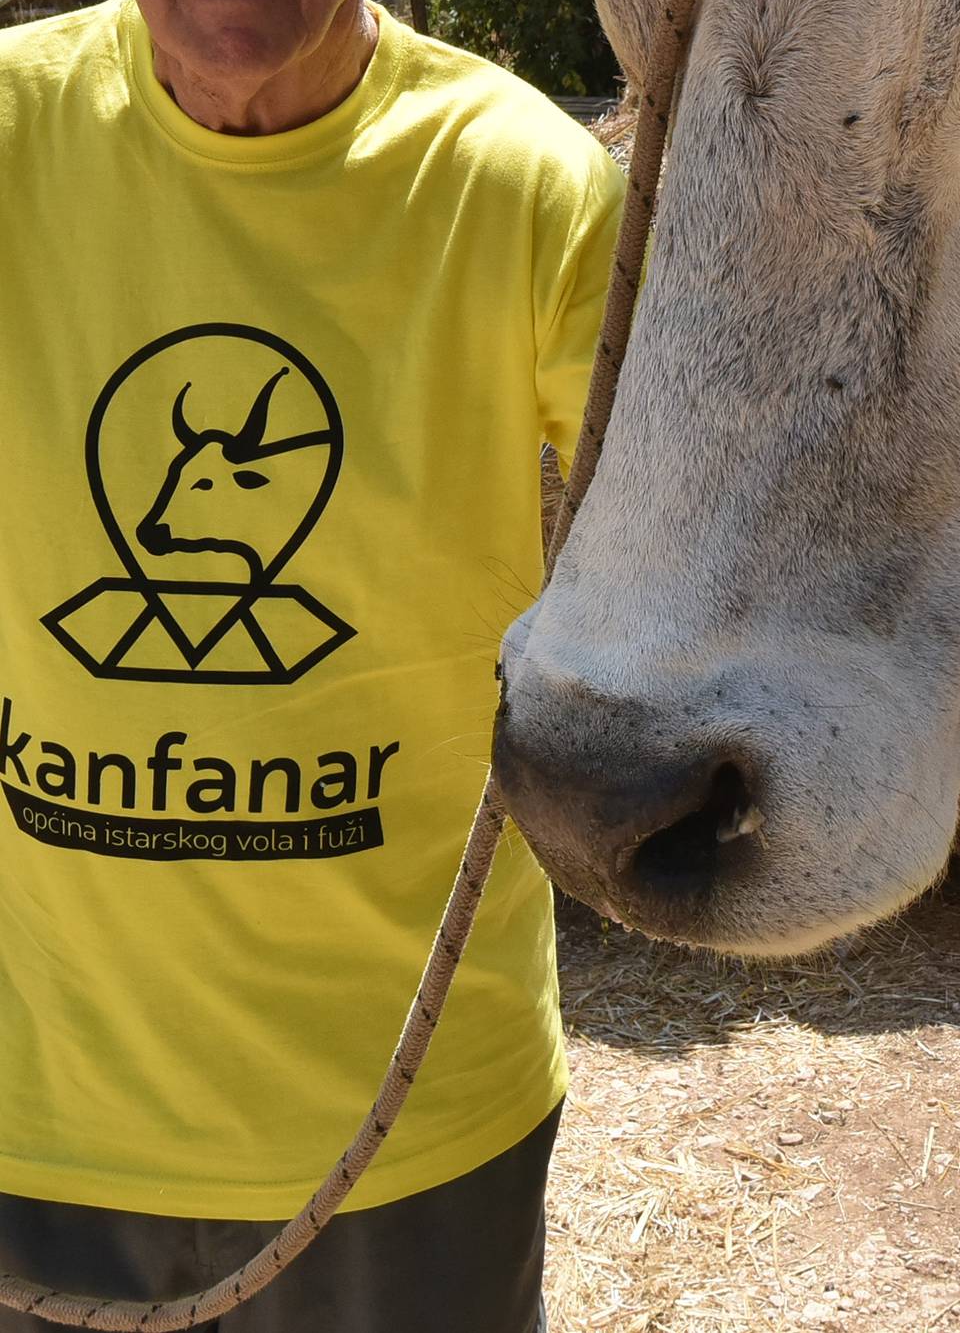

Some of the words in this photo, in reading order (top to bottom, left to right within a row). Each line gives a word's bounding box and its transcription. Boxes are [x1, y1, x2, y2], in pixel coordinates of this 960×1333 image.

[0, 697, 399, 813] kanfanar
[23, 807, 96, 841] općina
[105, 822, 227, 856] istarskog
[236, 829, 293, 851] vola
[303, 828, 308, 850] i
[318, 818, 364, 850] fuži
